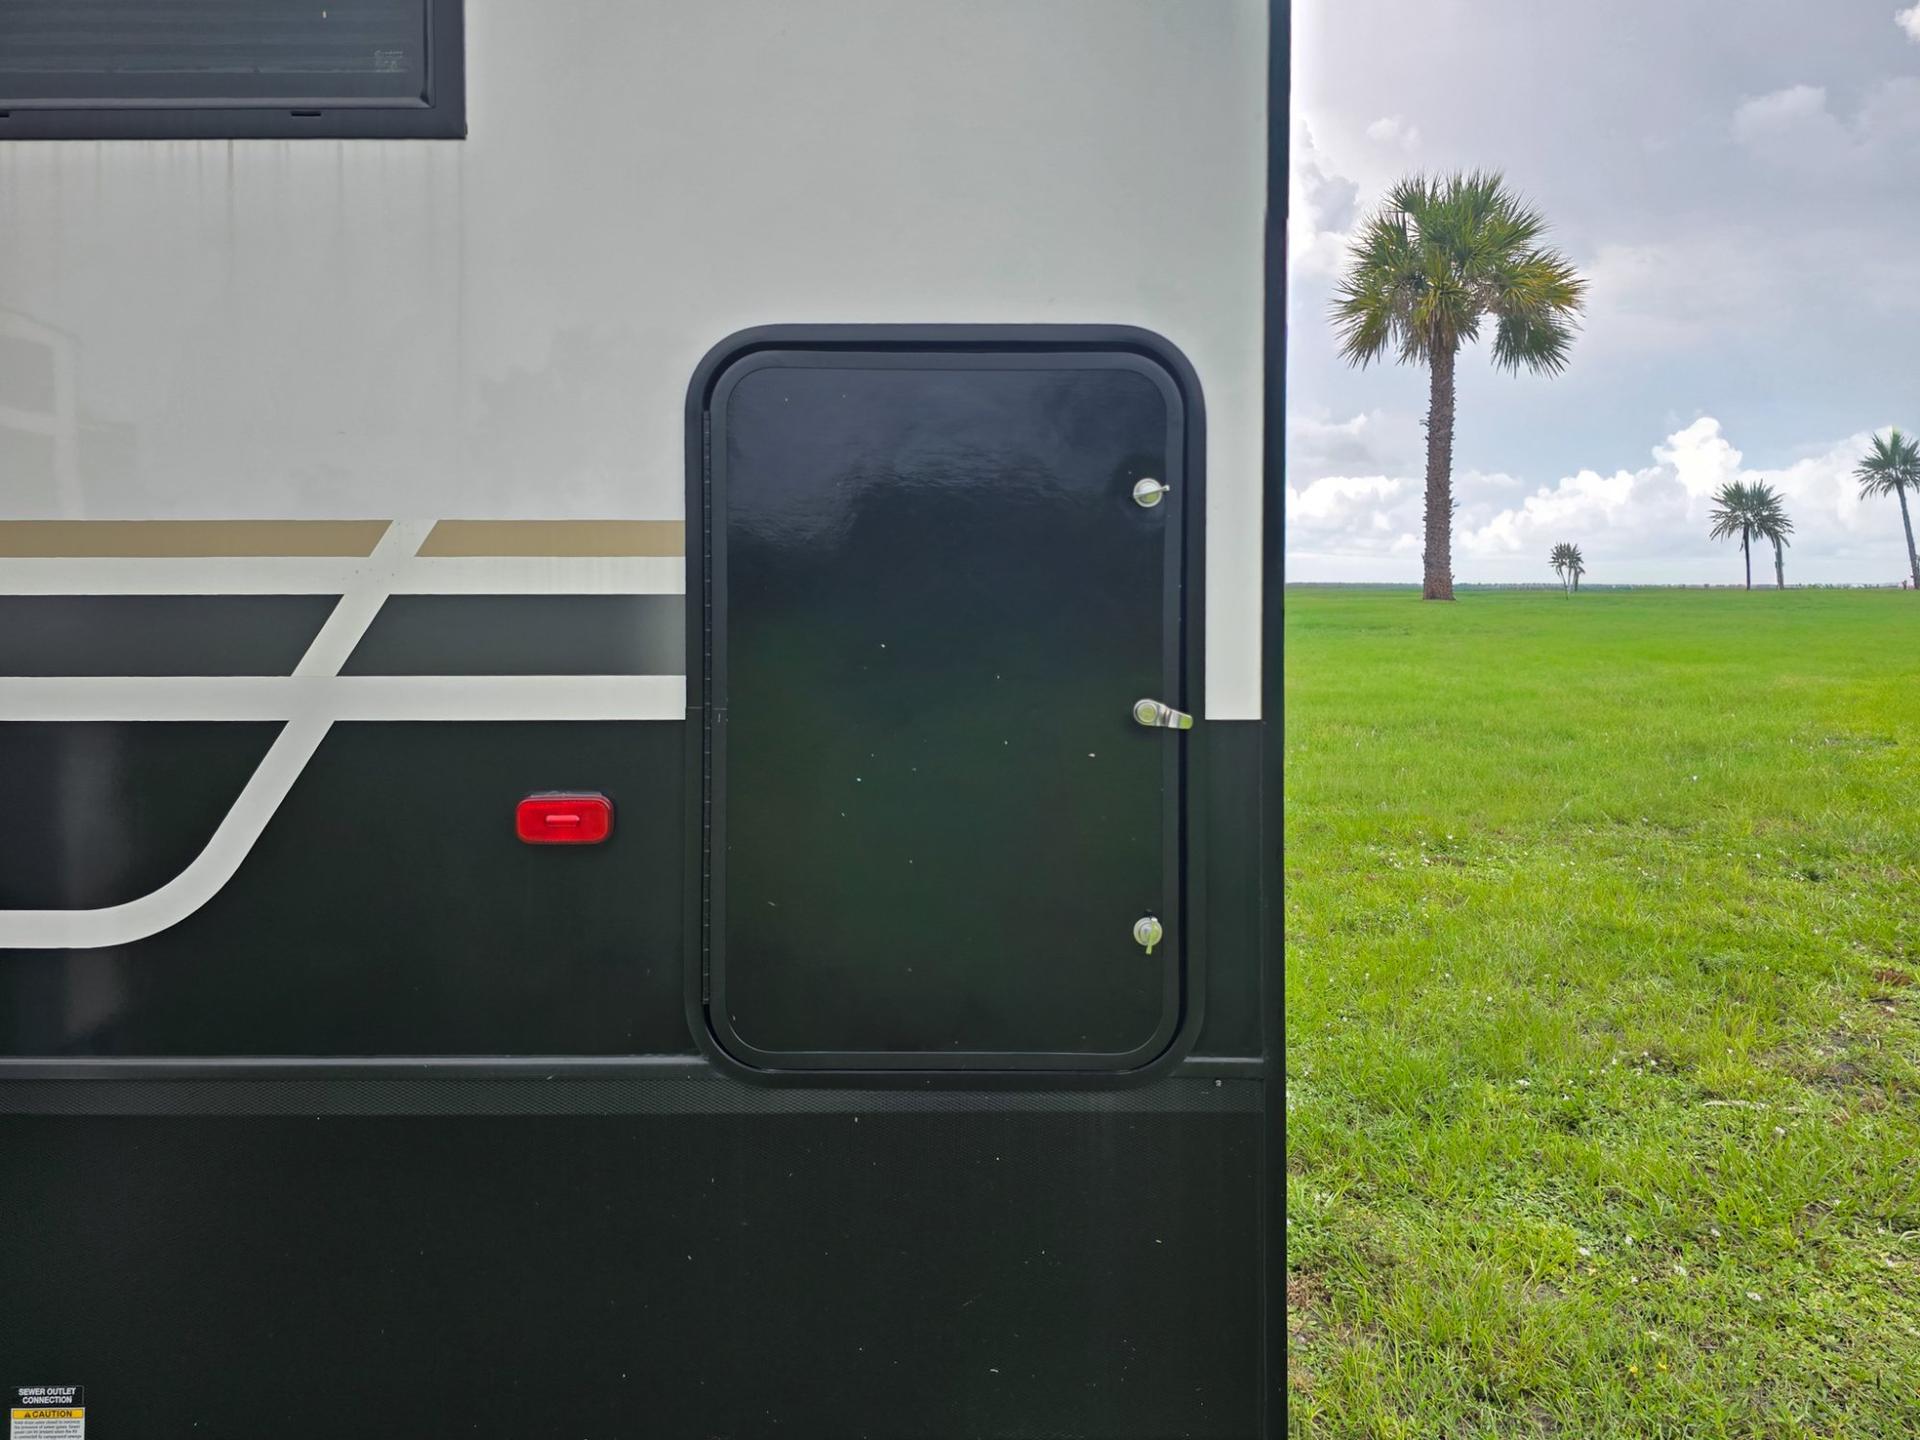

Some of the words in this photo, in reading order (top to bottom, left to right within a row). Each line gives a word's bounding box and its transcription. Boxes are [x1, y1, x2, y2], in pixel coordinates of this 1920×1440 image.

[18, 1387, 46, 1395] SEWER
[47, 1387, 76, 1395] OUTLET
[22, 1396, 72, 1404] CONNECTION
[32, 1410, 72, 1418] CAUTION
